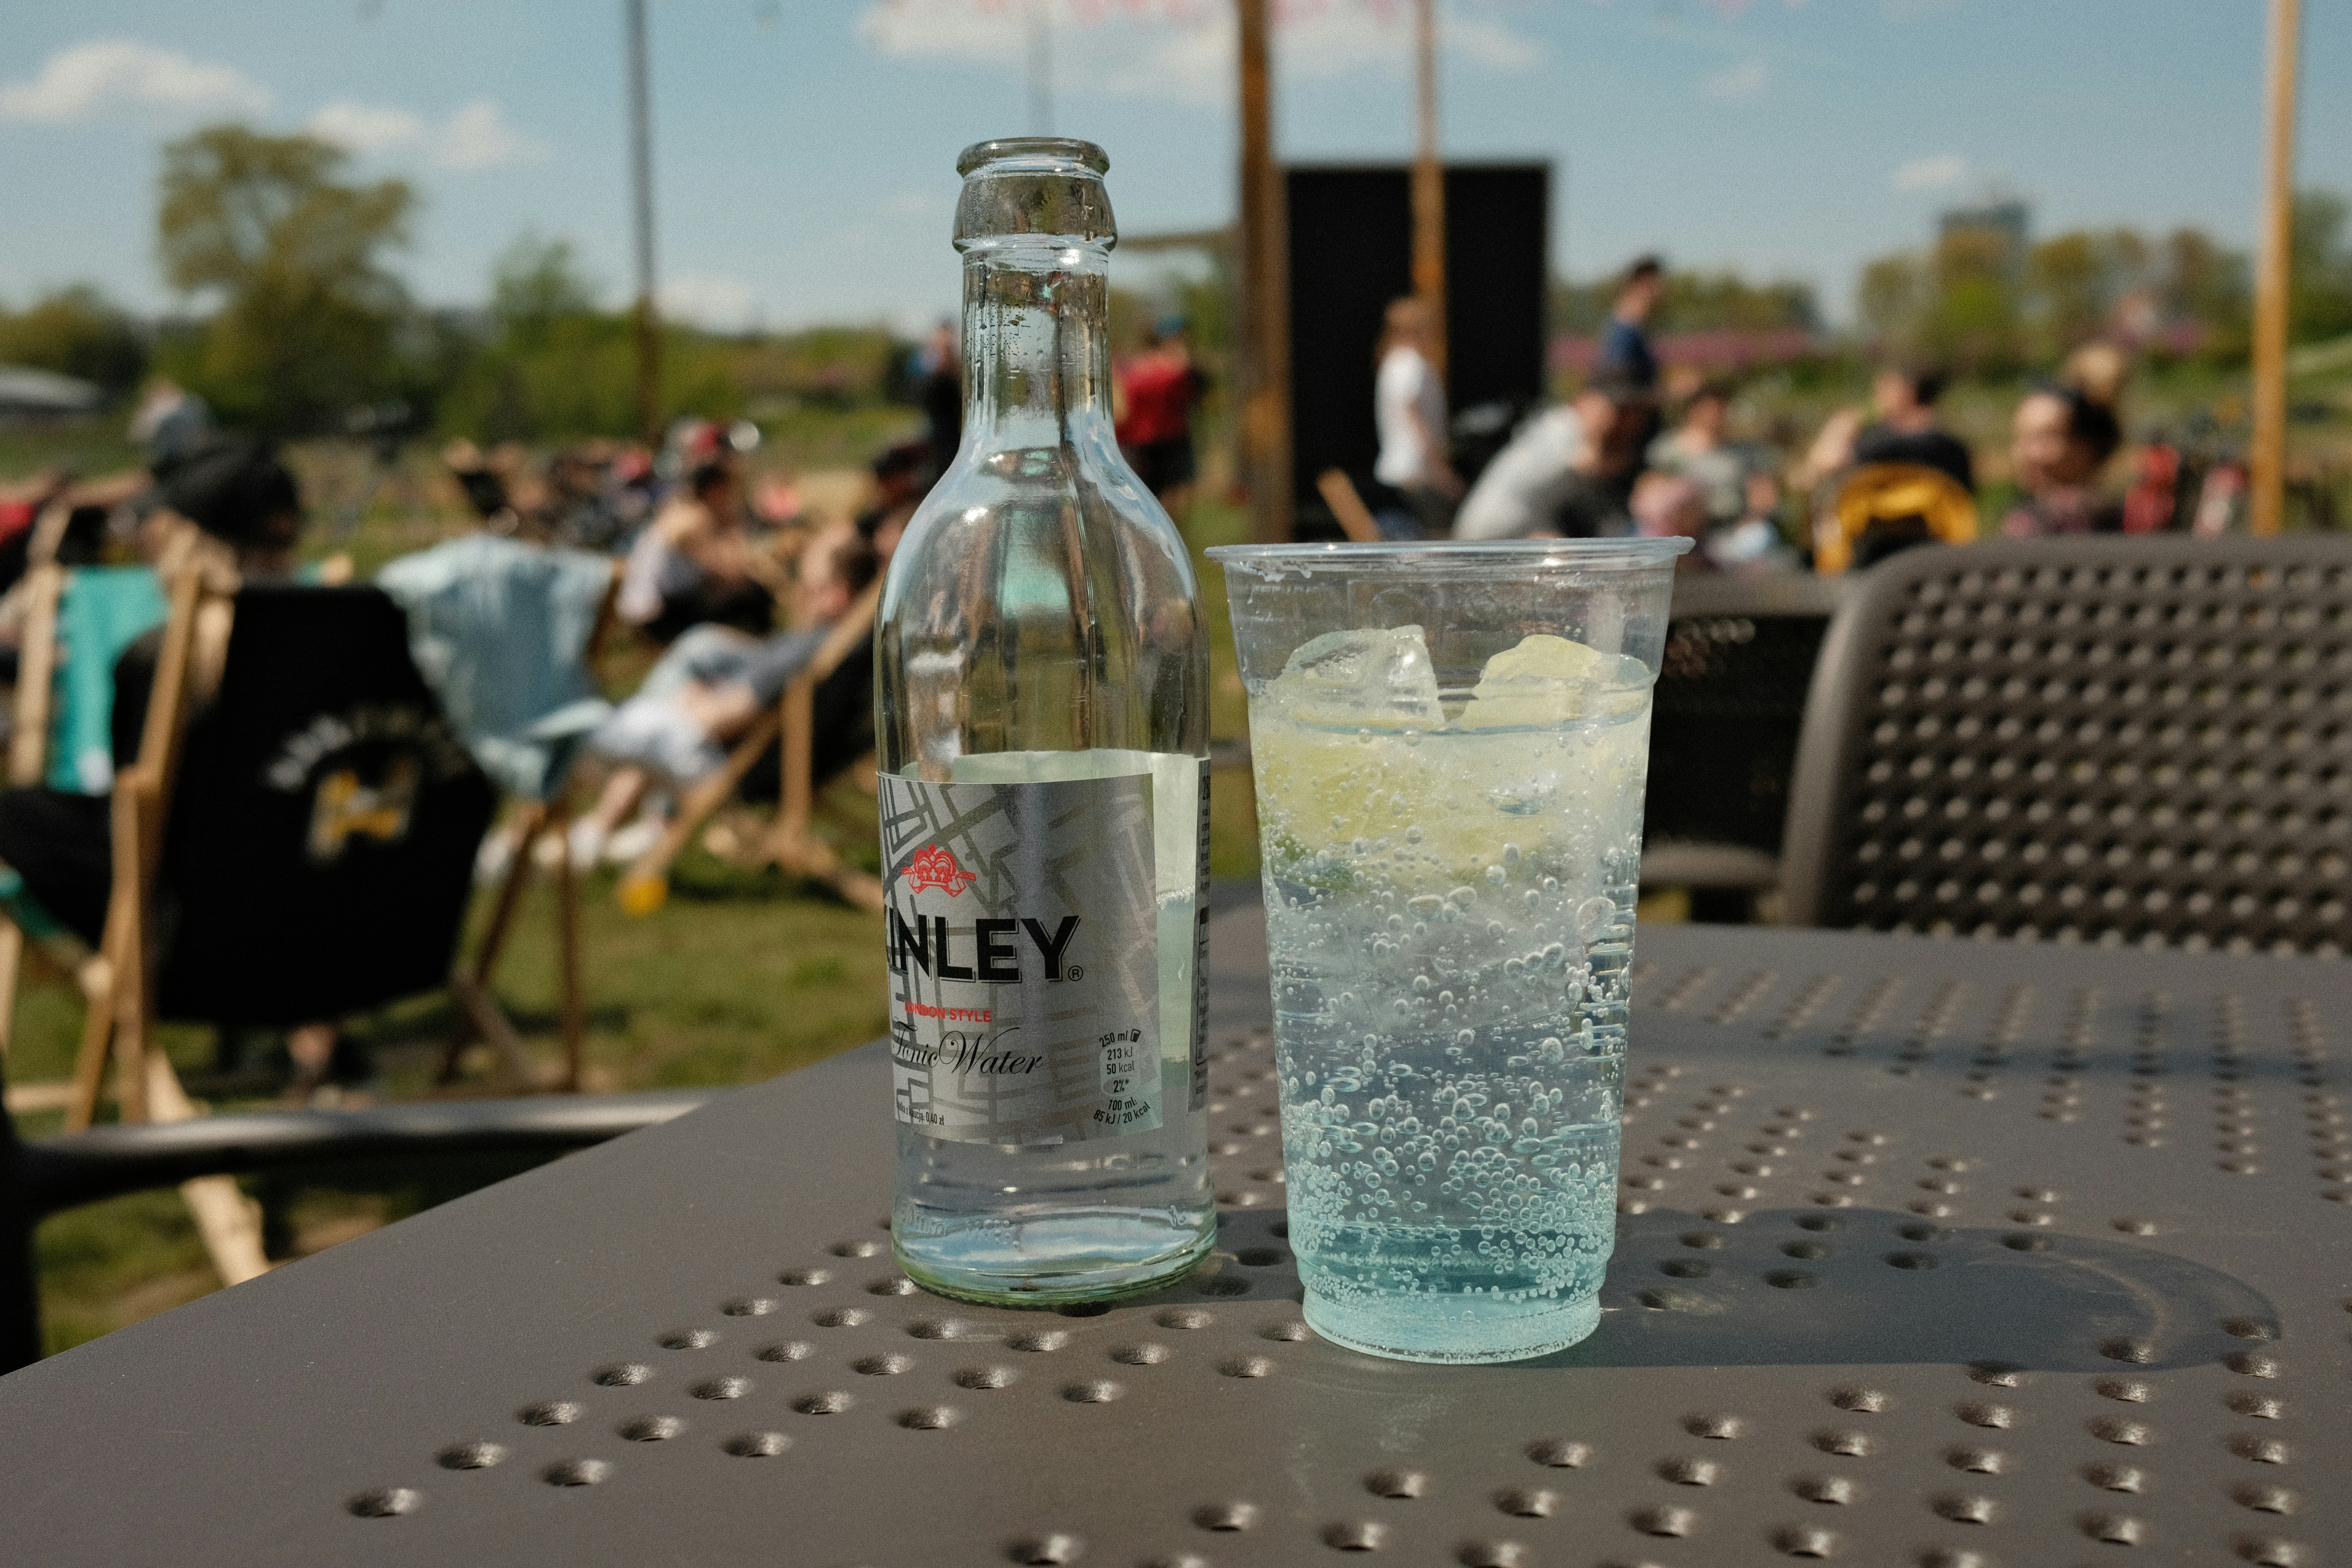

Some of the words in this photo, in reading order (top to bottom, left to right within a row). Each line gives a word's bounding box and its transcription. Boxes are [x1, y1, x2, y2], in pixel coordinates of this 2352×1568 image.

[884, 904, 1081, 983] INLEY
[904, 1000, 945, 1019] LONDON
[949, 1008, 992, 1023] STYLE
[893, 1017, 939, 1068] Tonic
[939, 1027, 1044, 1074] Water
[1099, 1032, 1115, 1047] 250
[1118, 1030, 1128, 1041] ml
[1107, 1048, 1122, 1060] 213
[1125, 1046, 1132, 1057] kJ
[1107, 1063, 1116, 1074] 50
[1119, 1061, 1135, 1072] kcal
[1109, 1099, 1122, 1110] 100
[1125, 1097, 1137, 1109] ml:
[926, 1112, 937, 1124] 0,40
[939, 1115, 945, 1125] zł
[1094, 1110, 1105, 1122] 85
[1106, 1113, 1115, 1124] kJ
[1123, 1112, 1132, 1123] 20
[1133, 1101, 1150, 1119] kcal
